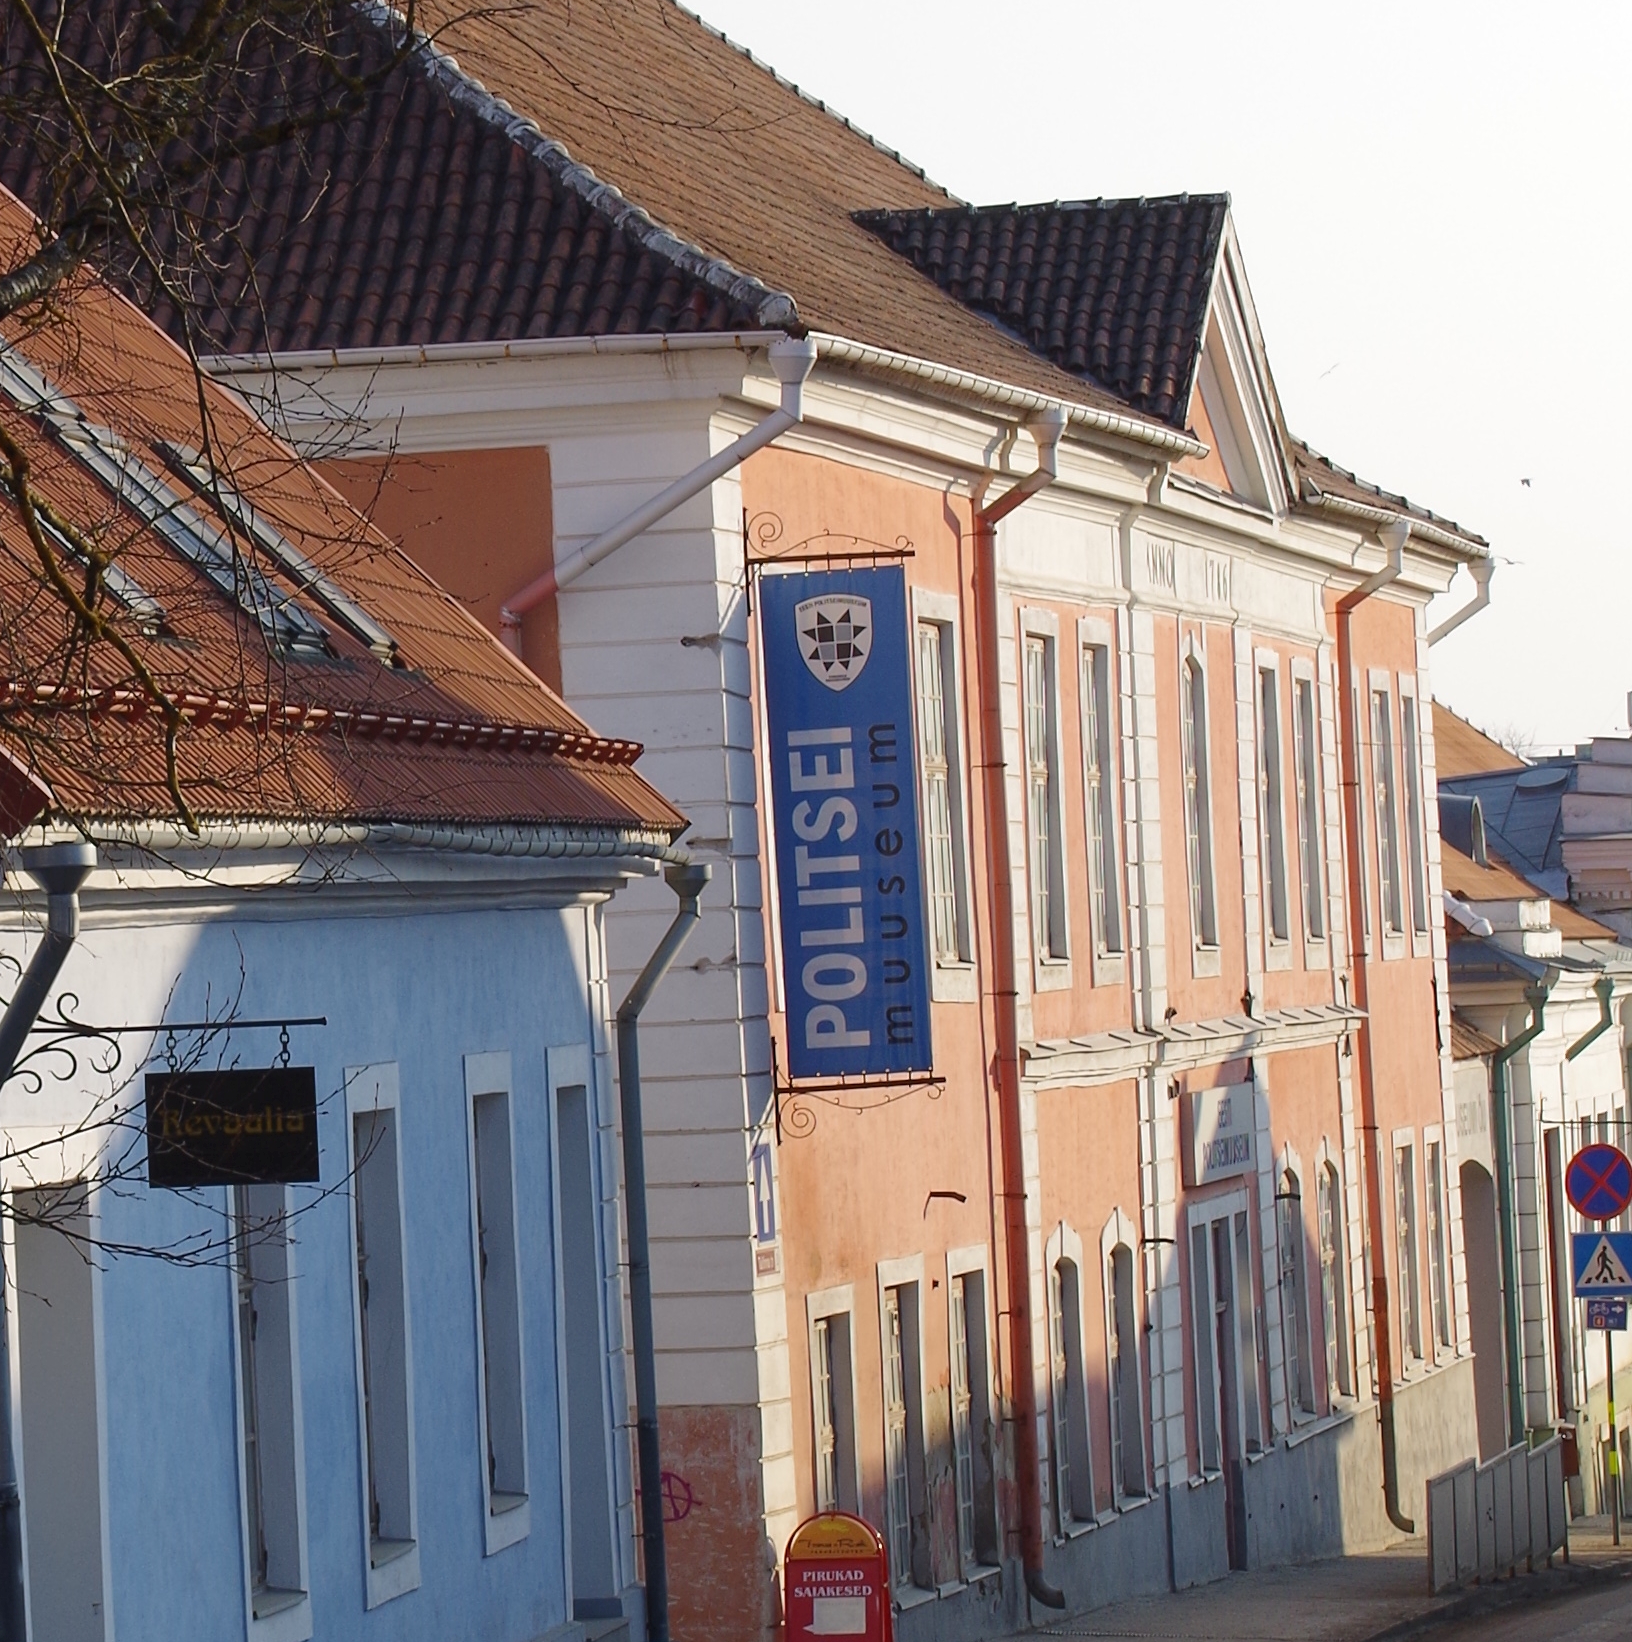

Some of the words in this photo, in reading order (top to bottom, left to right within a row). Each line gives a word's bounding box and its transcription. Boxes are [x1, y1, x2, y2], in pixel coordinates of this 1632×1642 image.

[1146, 542, 1173, 589] ANNO
[788, 726, 870, 1049] POLITSEI
[869, 723, 914, 1045] muuseum
[794, 1585, 873, 1598] SAIAKESED
[802, 1569, 864, 1582] PIRUKAD
